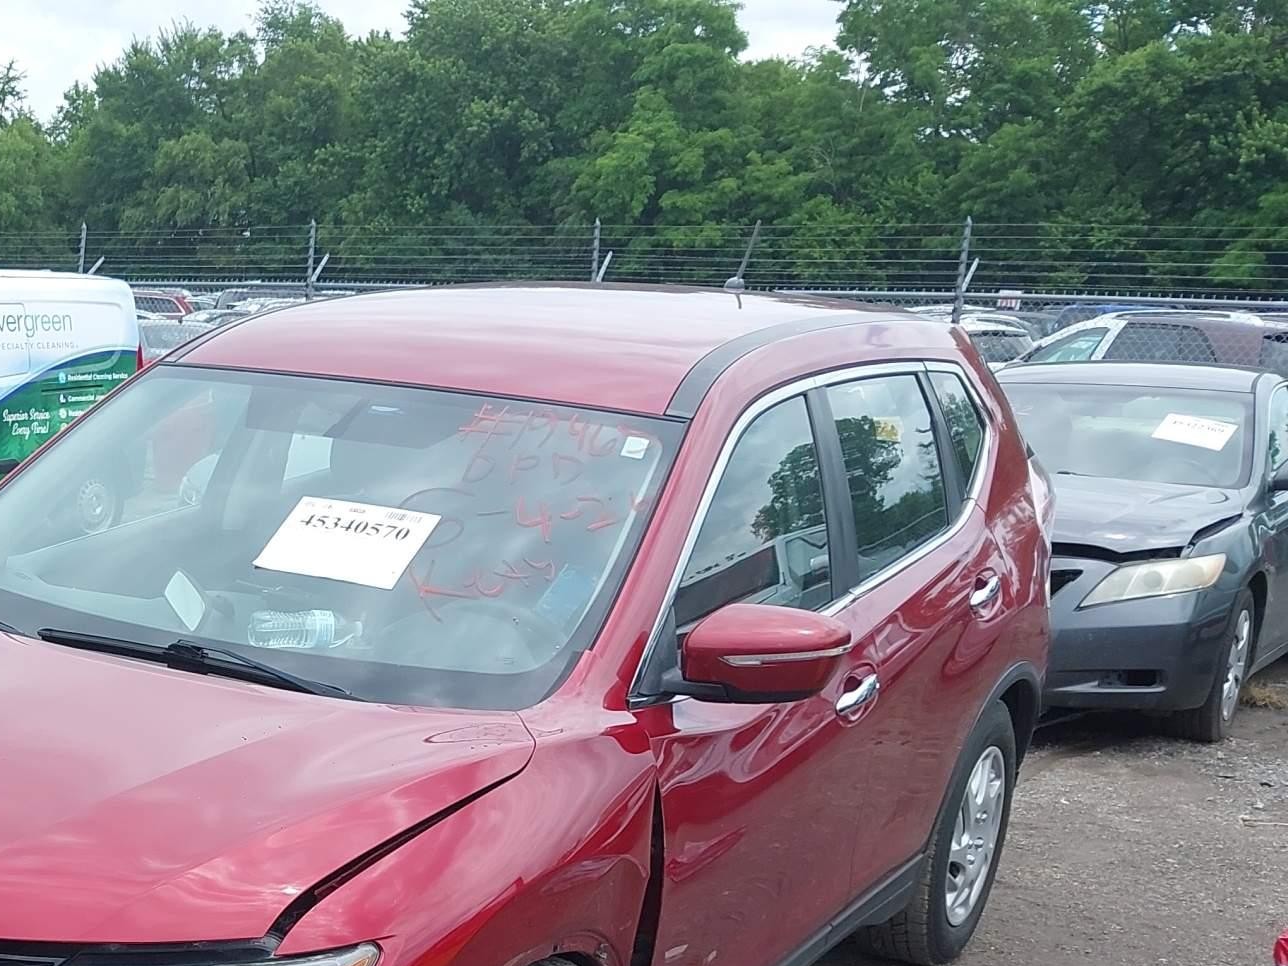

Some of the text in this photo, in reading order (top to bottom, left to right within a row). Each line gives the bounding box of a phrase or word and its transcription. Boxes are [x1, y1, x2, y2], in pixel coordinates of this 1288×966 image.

[2, 408, 29, 427] Superior
[29, 407, 51, 421] Service
[300, 513, 411, 540] 45340570
